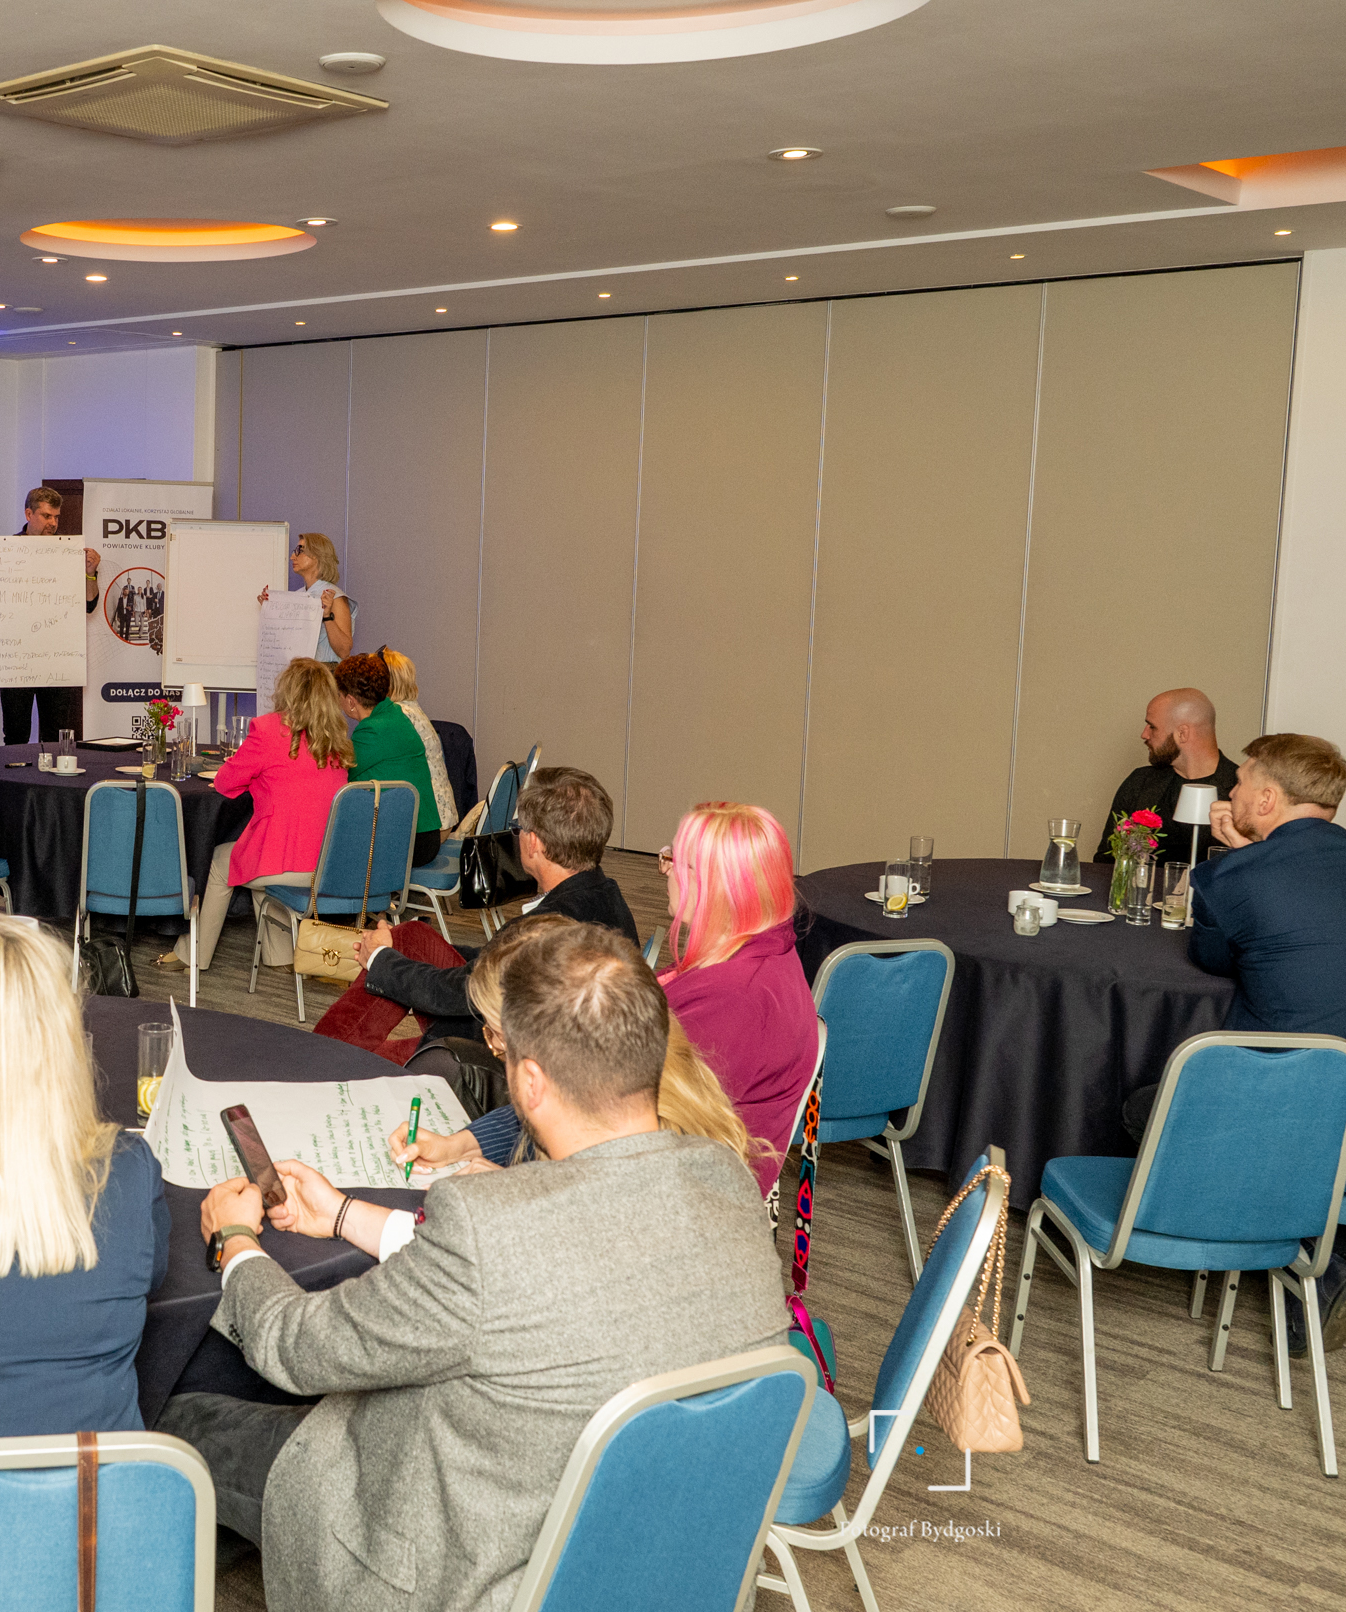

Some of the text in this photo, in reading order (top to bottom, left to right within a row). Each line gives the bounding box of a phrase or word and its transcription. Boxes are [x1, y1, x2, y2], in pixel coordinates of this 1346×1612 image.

[102, 518, 167, 540] PKB
[110, 688, 146, 698] DOŁĄCZ
[147, 688, 161, 697] DO
